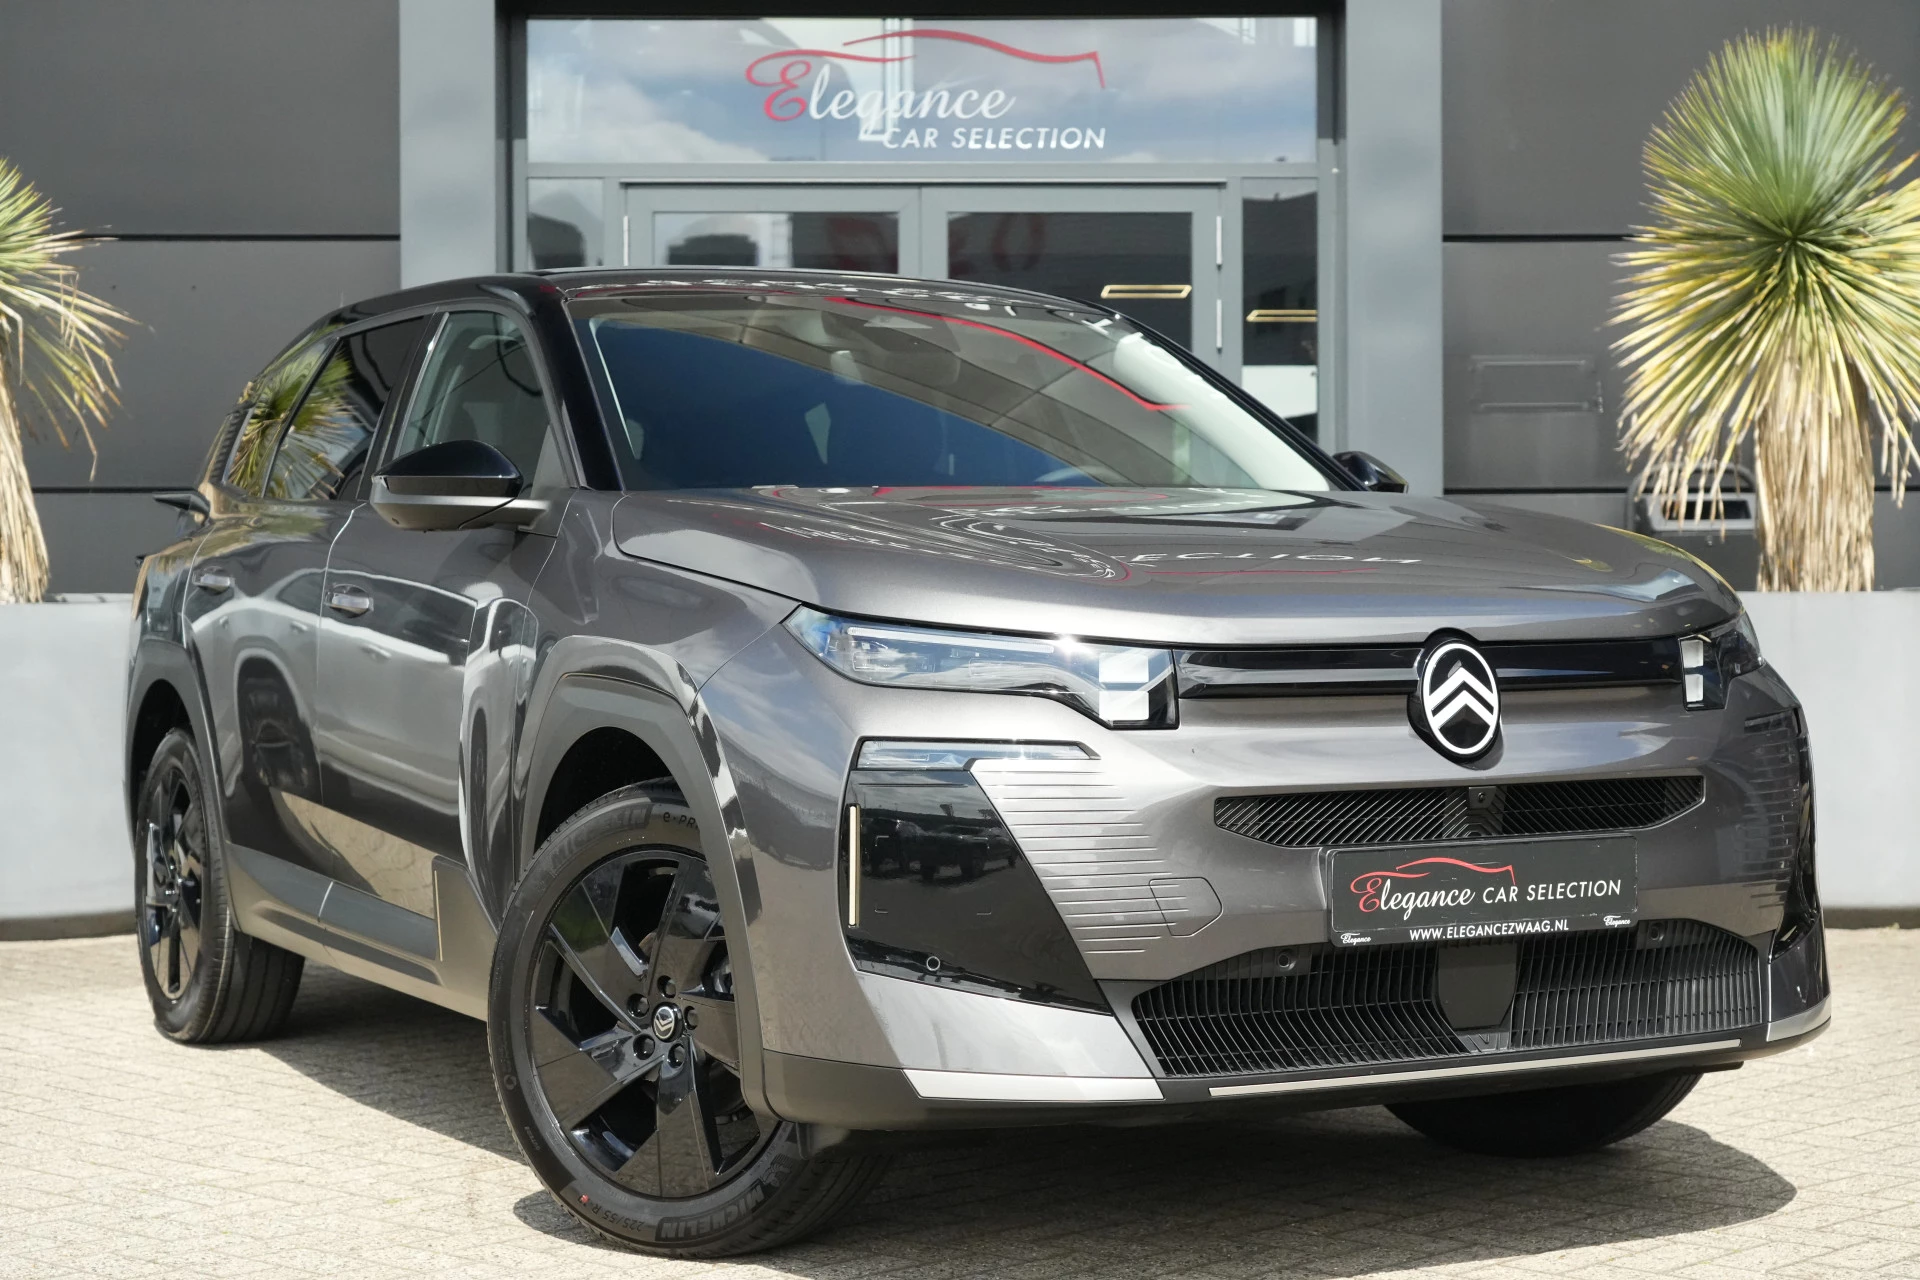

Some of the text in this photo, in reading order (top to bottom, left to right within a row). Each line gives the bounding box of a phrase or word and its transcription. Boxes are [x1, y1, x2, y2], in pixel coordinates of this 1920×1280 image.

[745, 51, 1016, 136] Elegance
[883, 127, 1106, 150] CAR SELECTION
[1350, 871, 1621, 920] Elegance CAR SELECTION
[1409, 919, 1569, 941] WWW.ELEGANCEZWAAG.NL
[1603, 914, 1631, 926] Elegance
[1340, 932, 1371, 945] Elegance
[662, 1185, 765, 1239] MICHELIN
